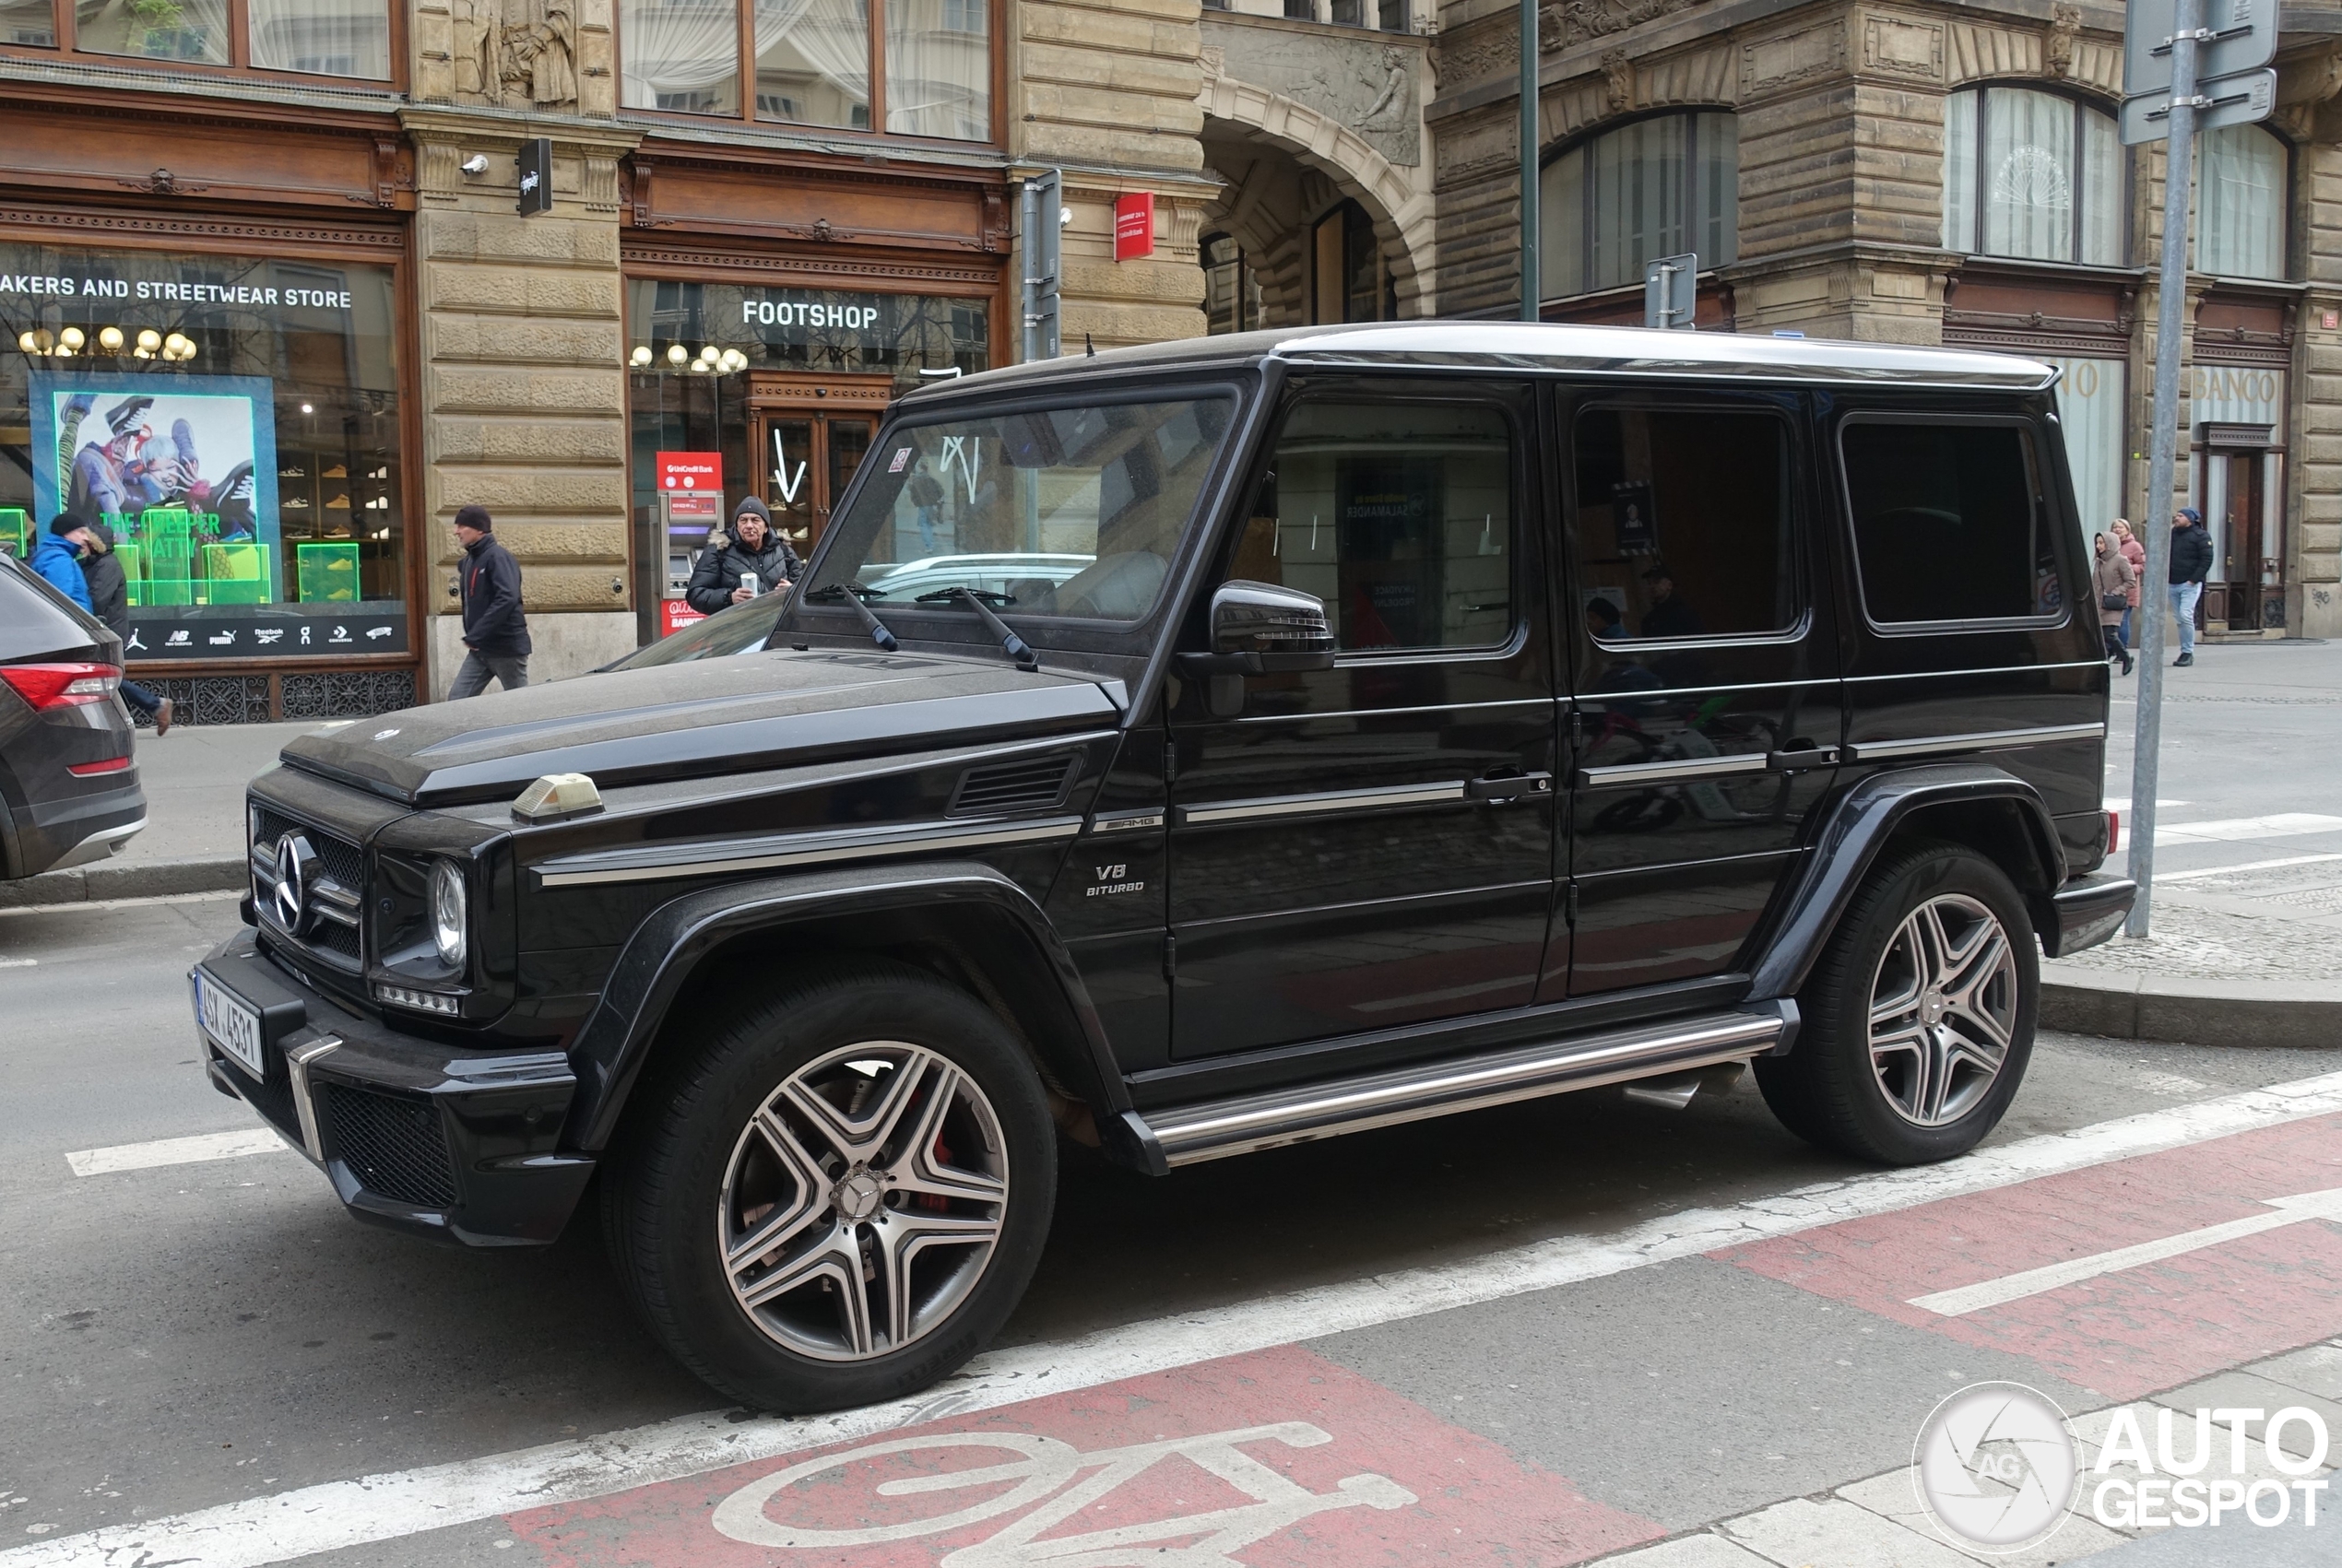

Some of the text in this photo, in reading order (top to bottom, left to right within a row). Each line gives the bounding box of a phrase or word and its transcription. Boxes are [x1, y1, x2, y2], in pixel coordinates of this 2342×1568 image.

[0, 275, 352, 309] AKERS AND STREETWEAR STORE
[742, 301, 878, 329] FOOTSHOP
[2191, 369, 2276, 404] BANCO
[674, 465, 714, 473] UniCredit Bank
[100, 513, 221, 535] THE CREEPER
[254, 628, 284, 636] Reebok
[209, 636, 231, 645] PUMA
[1121, 818, 1155, 828] AMG
[1095, 864, 1127, 880] V8
[1086, 881, 1144, 897] BITURBO
[227, 1002, 255, 1064] 4531
